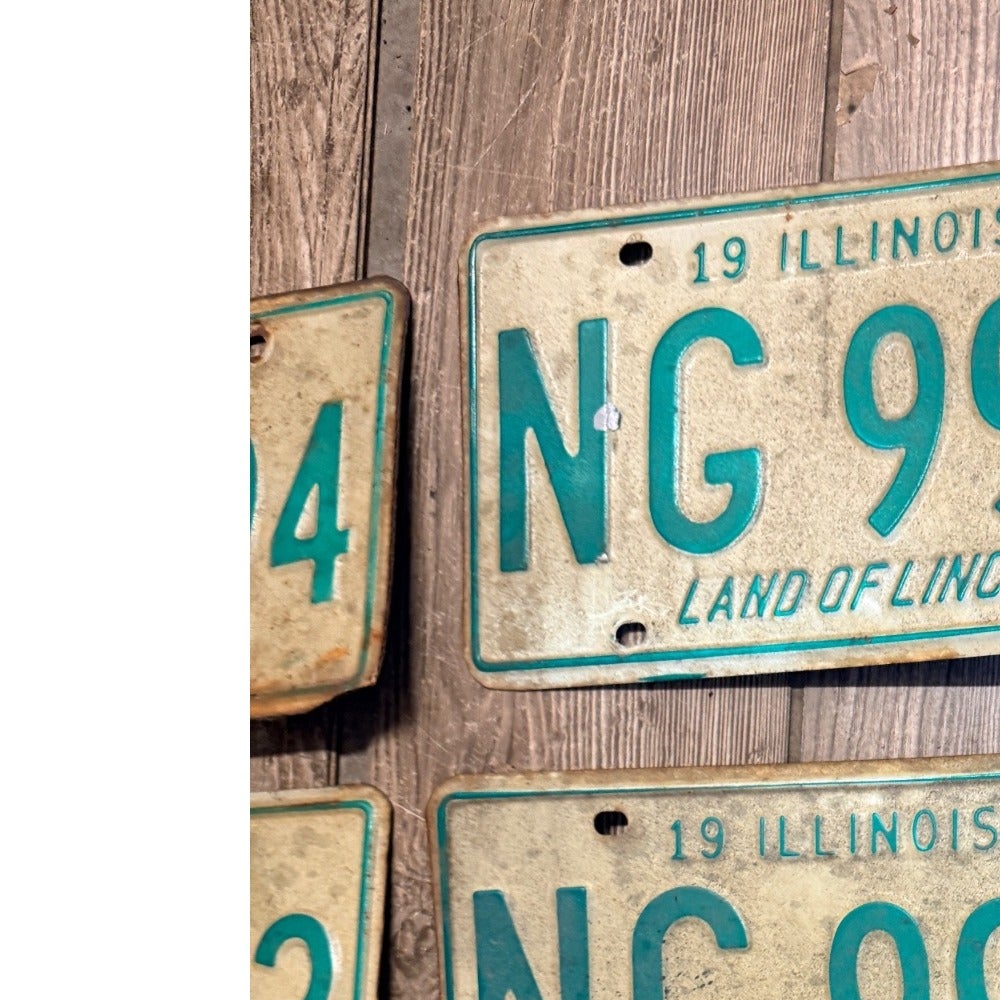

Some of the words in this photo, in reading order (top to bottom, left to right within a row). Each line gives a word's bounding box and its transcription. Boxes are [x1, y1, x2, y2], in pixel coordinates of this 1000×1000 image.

[693, 236, 746, 283] 19
[497, 306, 765, 573] NG
[250, 400, 351, 605] 4
[678, 569, 808, 626] LAND
[818, 562, 889, 614] OF
[670, 816, 724, 861] 19
[759, 805, 999, 858] ILLINOIS
